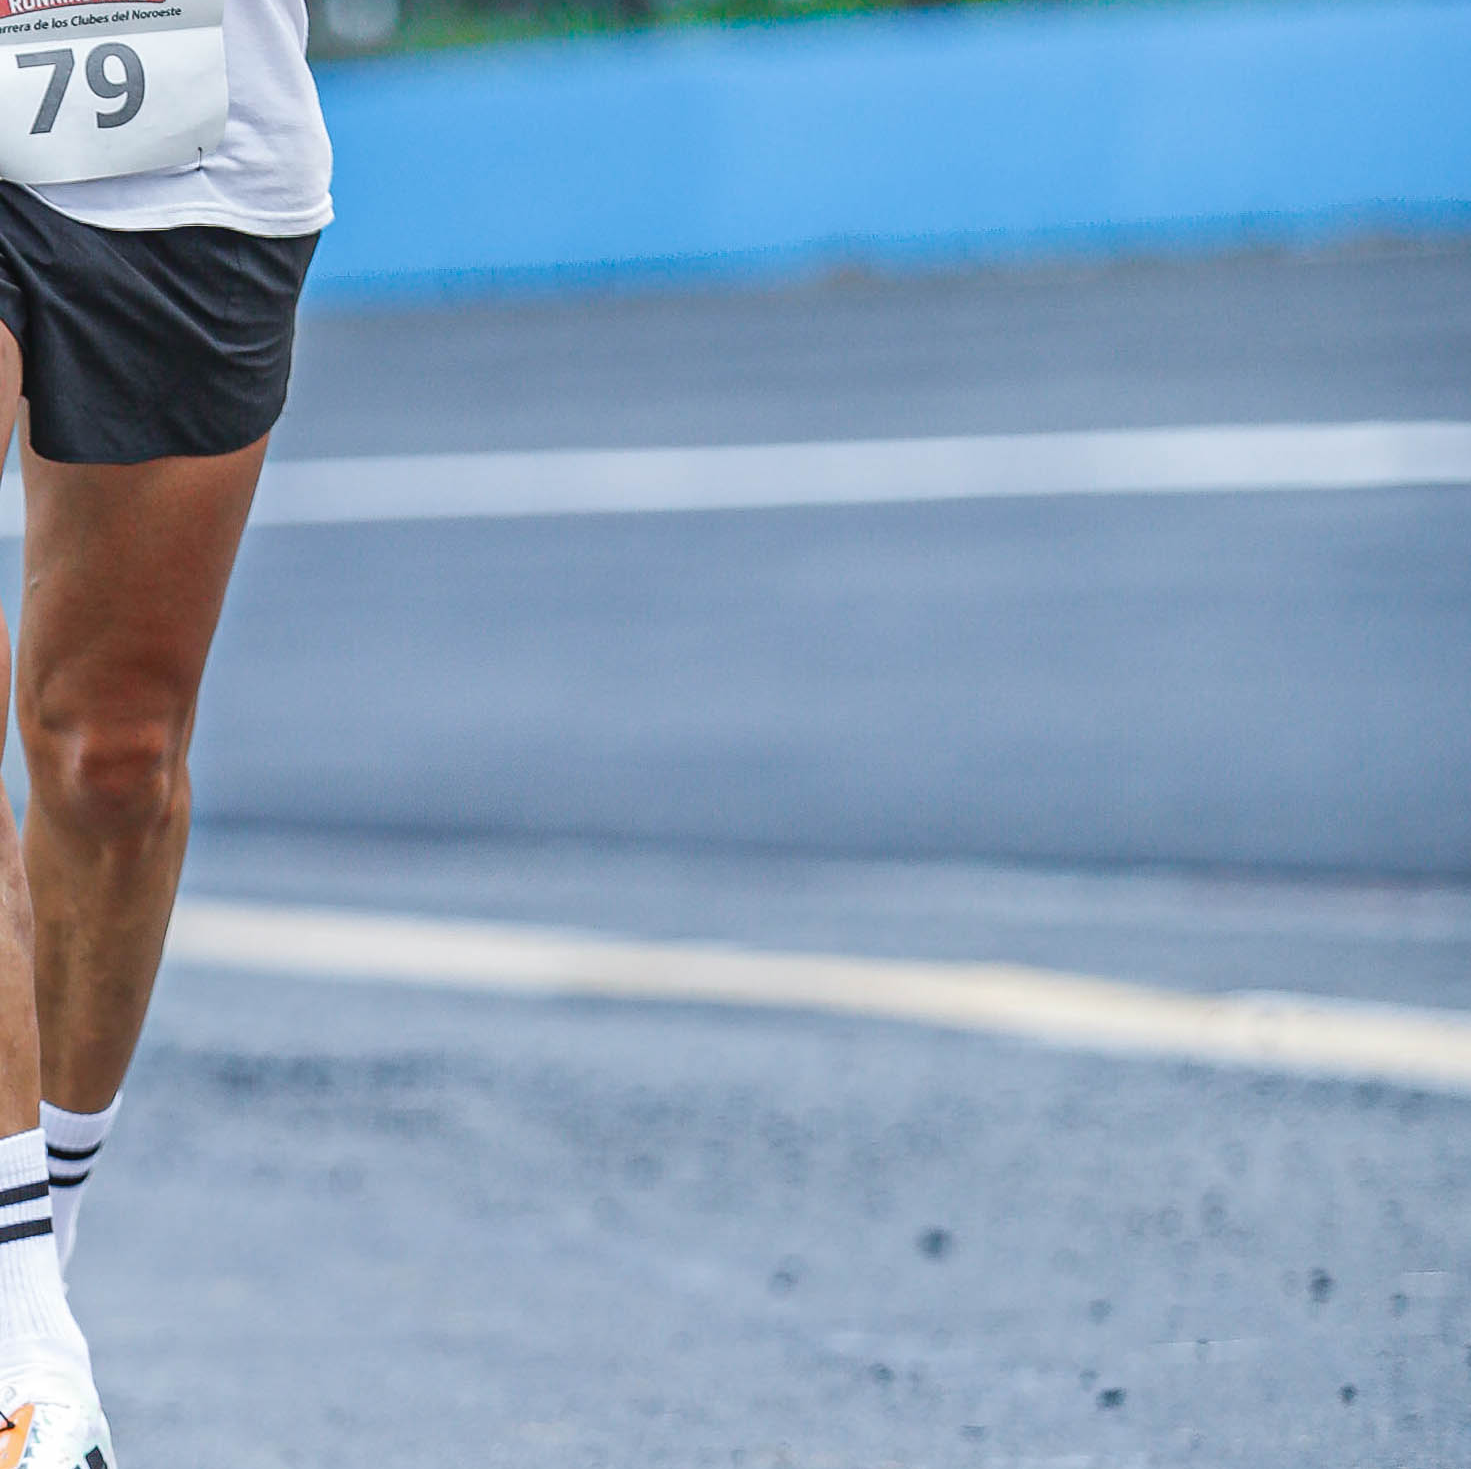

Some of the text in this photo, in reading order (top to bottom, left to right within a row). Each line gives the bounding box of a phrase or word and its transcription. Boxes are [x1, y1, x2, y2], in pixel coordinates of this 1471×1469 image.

[33, 19, 49, 31] de
[51, 18, 68, 29] los
[71, 14, 109, 27] Clubes
[111, 10, 129, 22] del
[131, 6, 182, 21] Noroeste
[15, 42, 146, 135] 79
